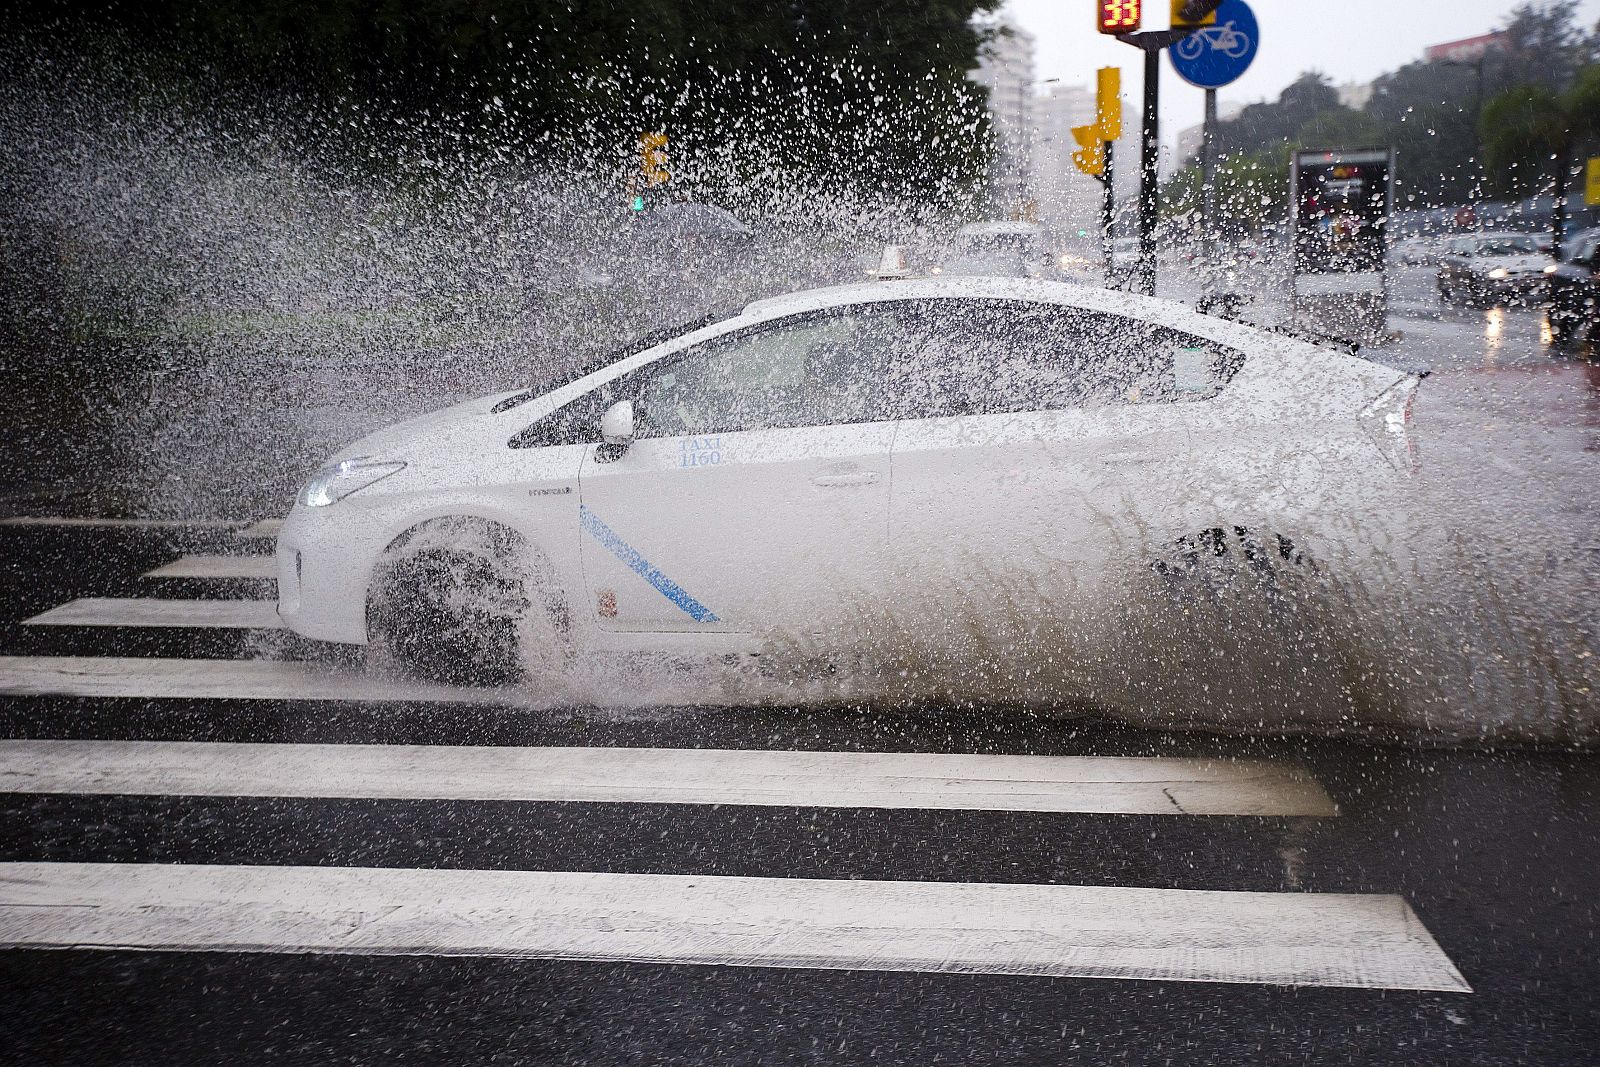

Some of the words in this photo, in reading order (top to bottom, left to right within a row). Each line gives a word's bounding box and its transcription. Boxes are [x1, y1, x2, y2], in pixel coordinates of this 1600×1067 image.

[1104, 0, 1138, 26] 33
[679, 438, 721, 451] TAXI
[680, 451, 721, 468] 1160
